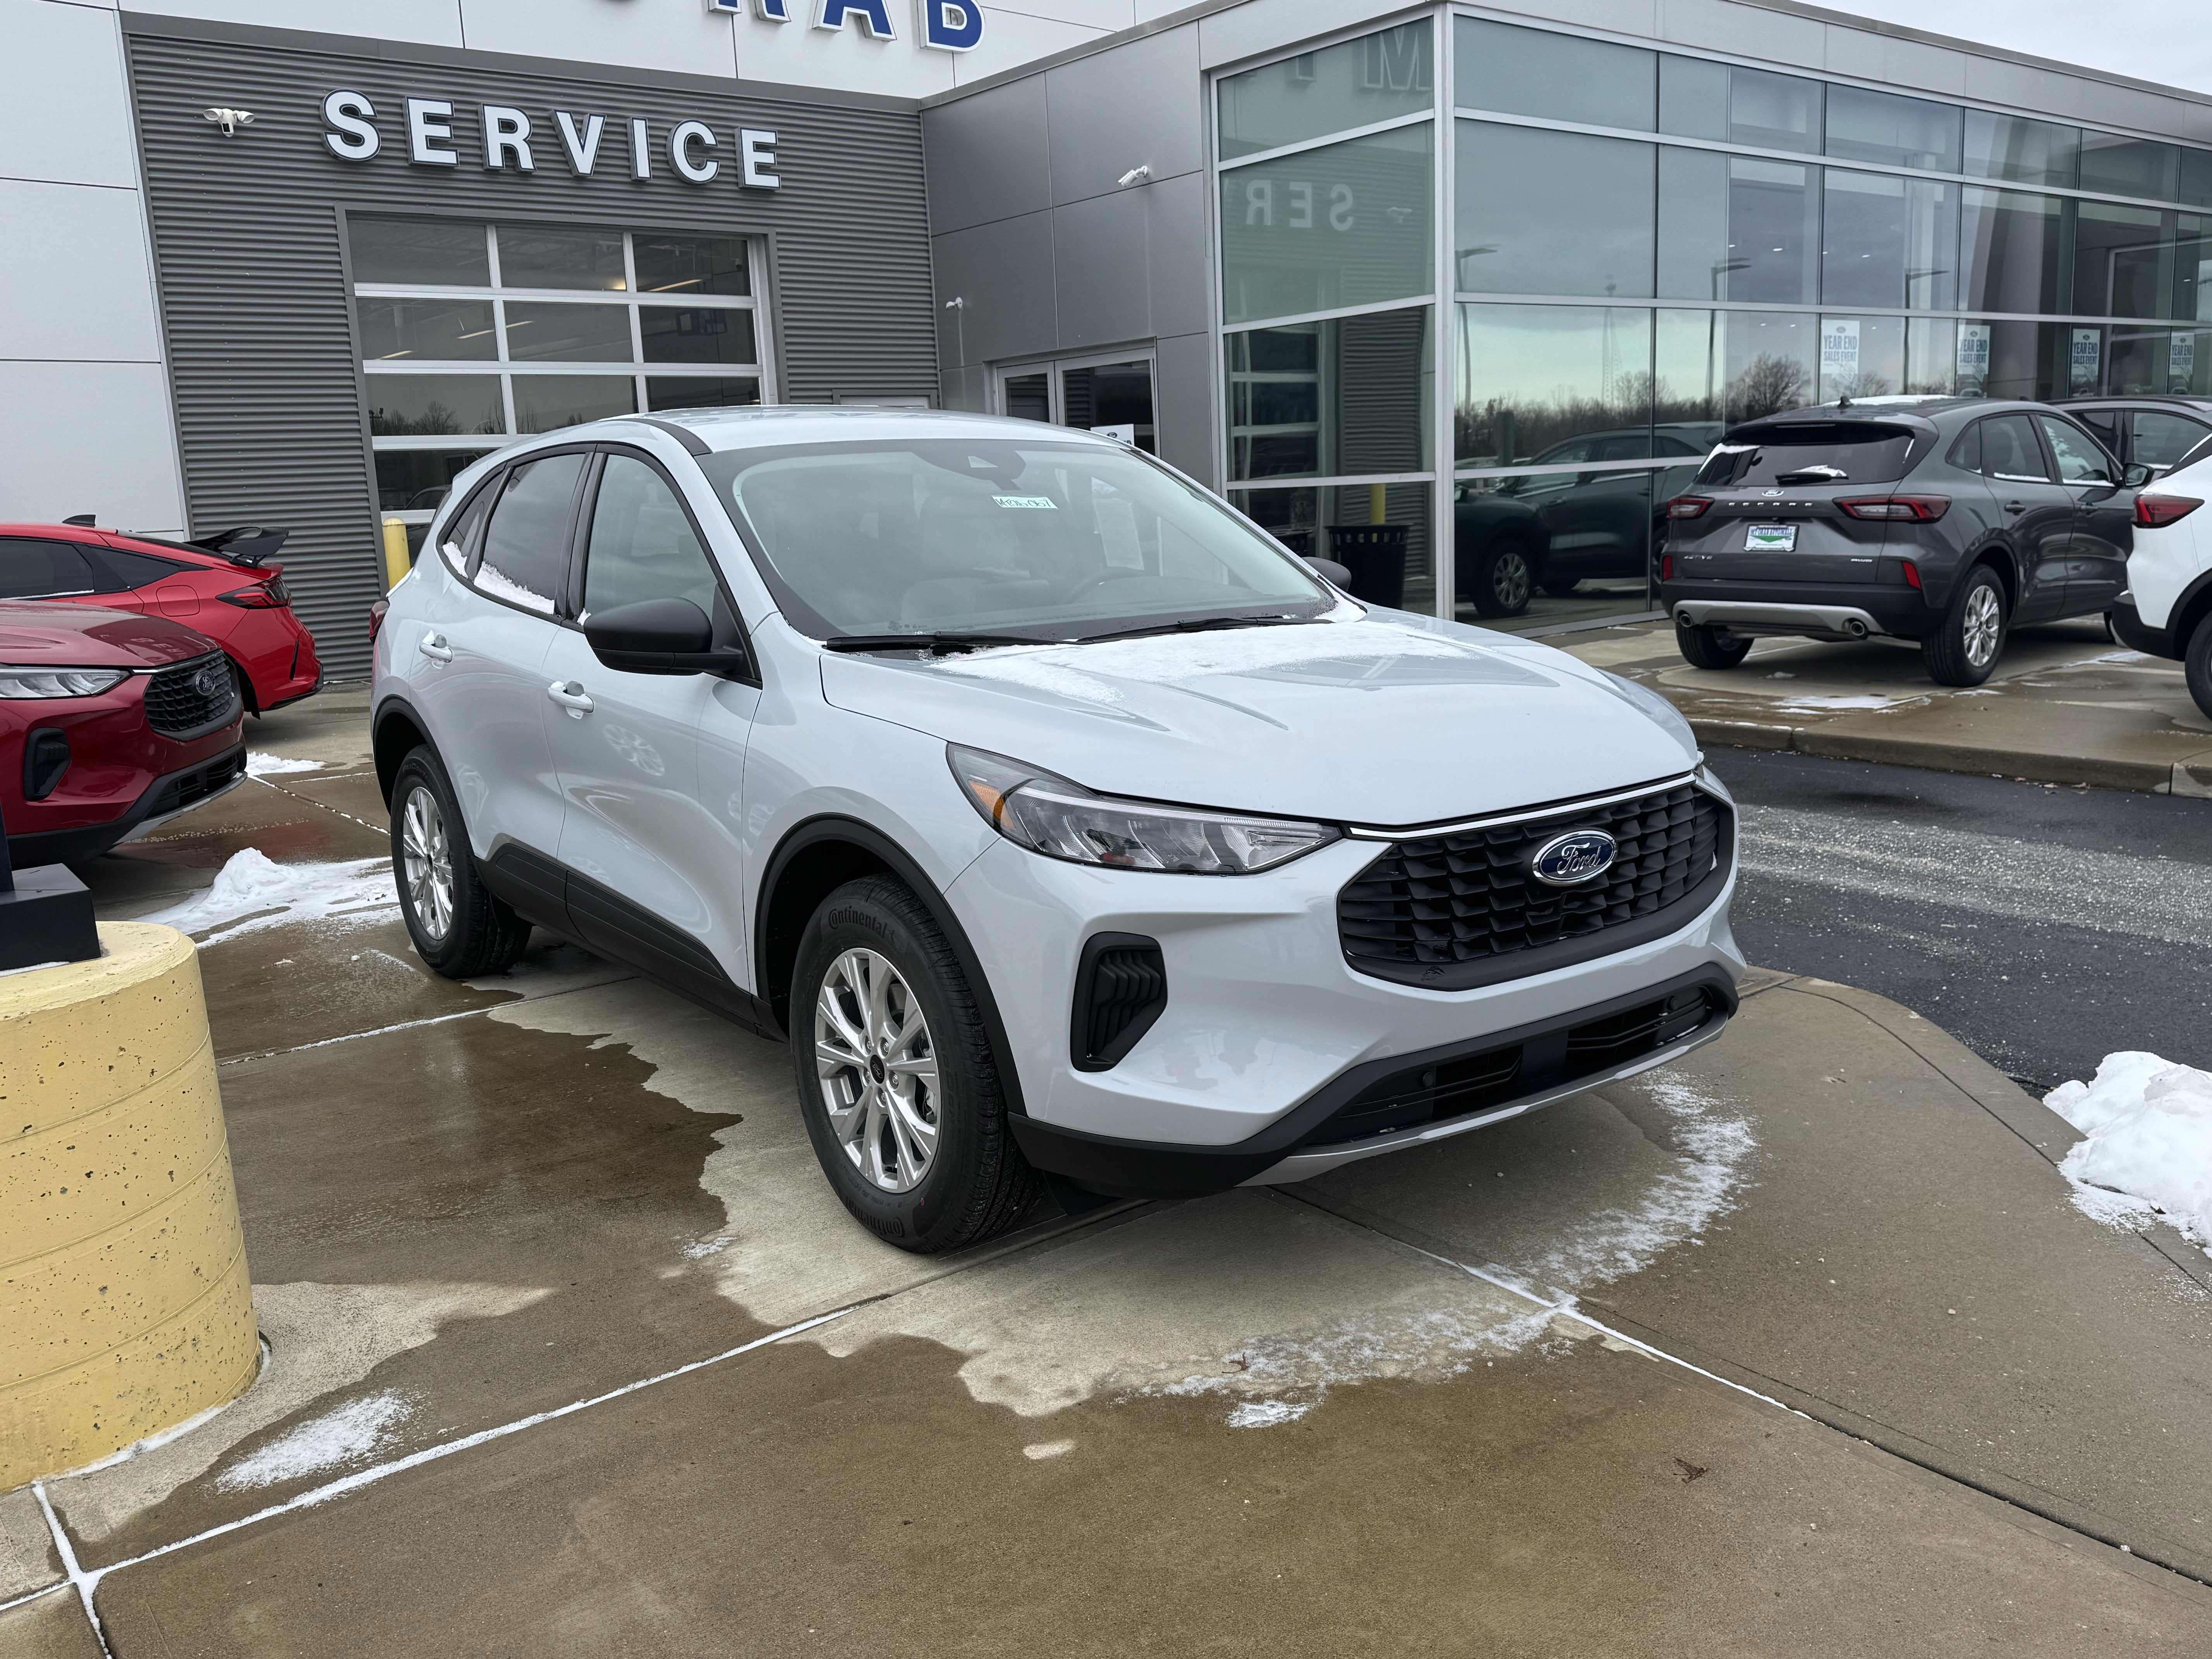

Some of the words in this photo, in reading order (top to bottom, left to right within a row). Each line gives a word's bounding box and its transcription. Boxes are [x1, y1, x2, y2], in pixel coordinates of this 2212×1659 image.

[320, 88, 781, 189] SERVICE
[1824, 335, 1842, 350] YEAR
[1844, 336, 1857, 350] END
[1976, 340, 1987, 352] END
[2073, 342, 2087, 354] YEAR
[2088, 343, 2098, 354] END
[1824, 351, 1840, 361] SALES
[1841, 352, 1856, 361] EVENT
[1557, 842, 1601, 874] Ford
[828, 905, 888, 939] Continental
